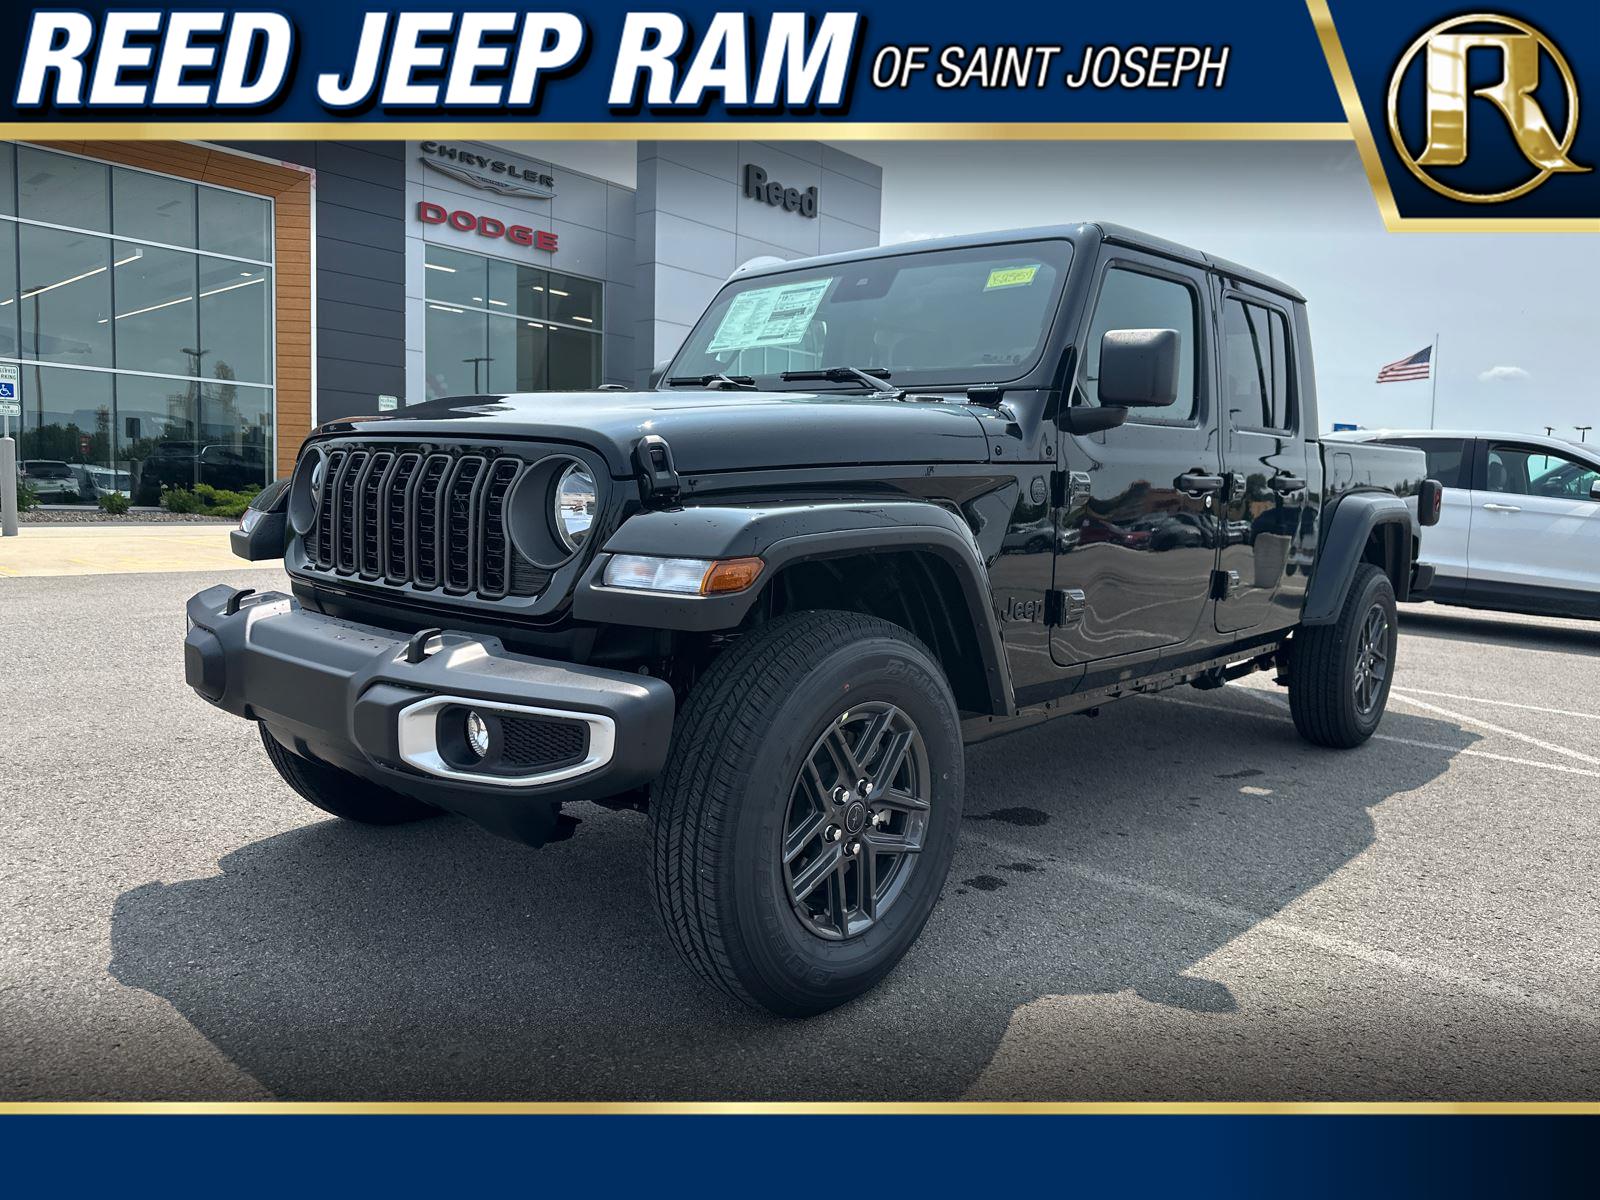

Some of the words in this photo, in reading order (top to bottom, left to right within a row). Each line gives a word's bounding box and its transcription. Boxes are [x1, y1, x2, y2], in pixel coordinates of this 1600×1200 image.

[420, 141, 554, 187] CHRYSLER
[744, 163, 818, 219] Reed
[417, 200, 559, 253] DODGE
[1001, 597, 1043, 622] Jeep
